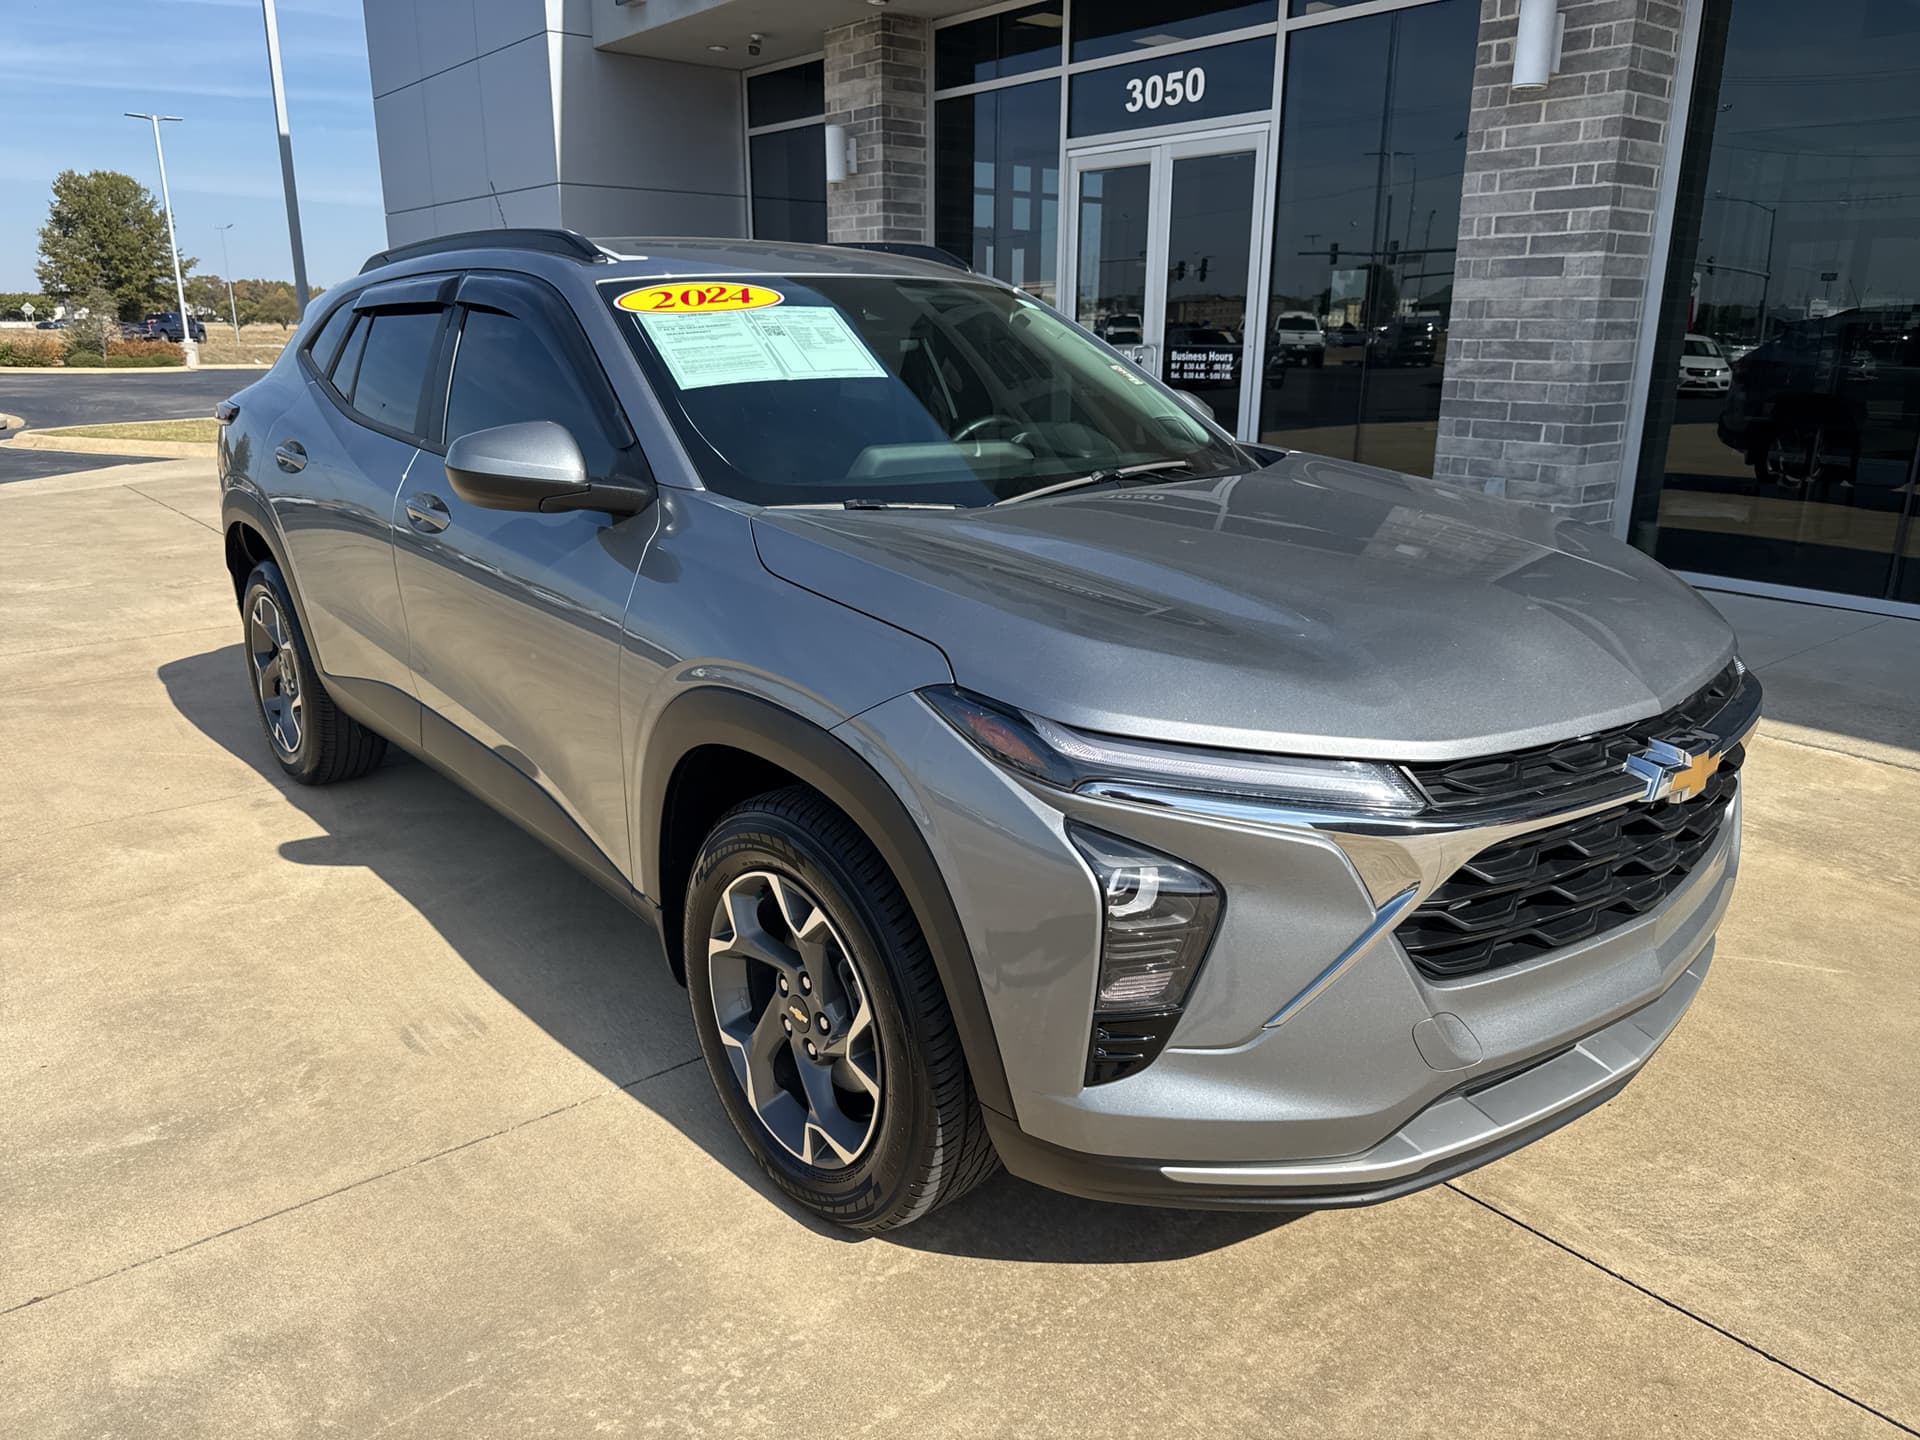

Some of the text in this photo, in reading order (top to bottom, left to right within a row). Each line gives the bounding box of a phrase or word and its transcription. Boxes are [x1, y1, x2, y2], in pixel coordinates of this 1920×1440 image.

[1125, 67, 1205, 112] 3050
[649, 286, 754, 310] 2024
[1171, 350, 1234, 362] Business Hours
